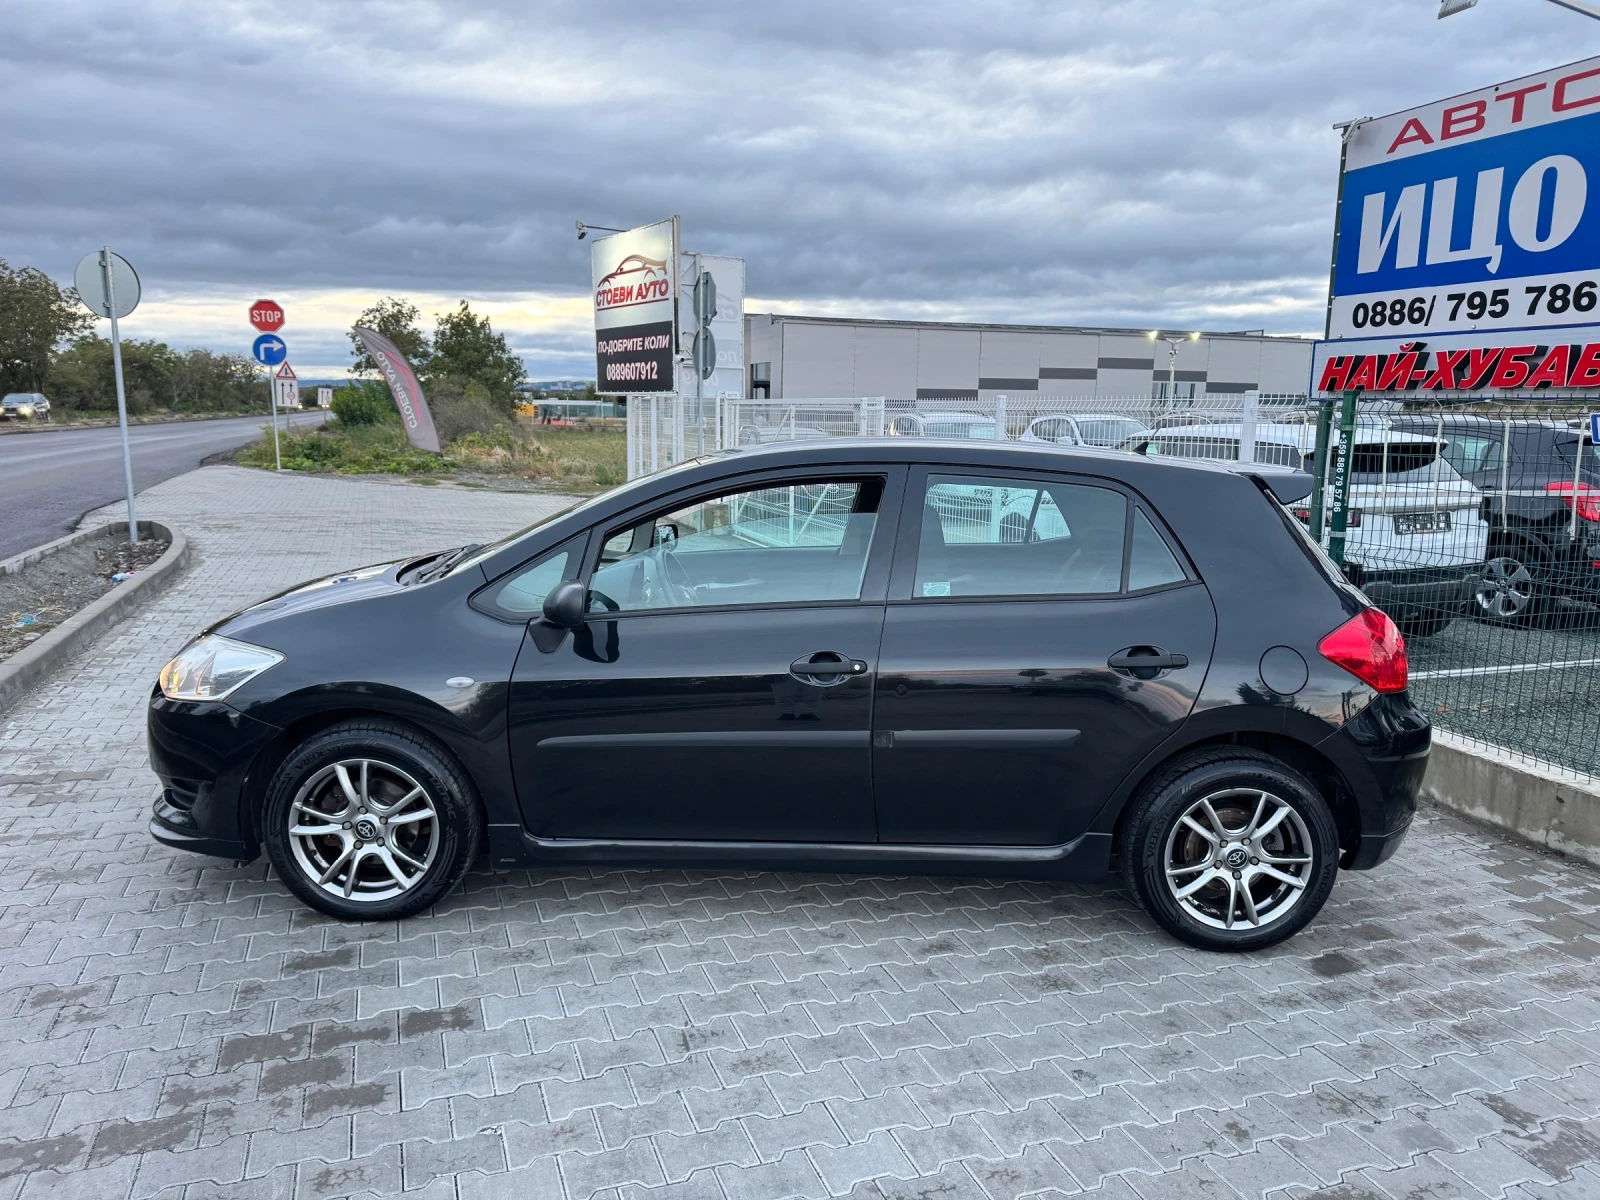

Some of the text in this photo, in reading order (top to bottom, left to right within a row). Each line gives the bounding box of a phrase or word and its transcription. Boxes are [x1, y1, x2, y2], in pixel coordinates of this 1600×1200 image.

[1357, 154, 1588, 275] ИЦО
[596, 278, 669, 307] СТОЕВИ АУТО
[1352, 281, 1598, 328] 0886/ 795 786
[252, 310, 281, 322] STOP
[597, 334, 669, 356] ПО-ДОБРИТЕ КОЛИ
[606, 360, 659, 381] 0889607912
[1333, 433, 1348, 513] +359 886 79 57 86
[1146, 801, 1180, 858] VREDESTEIN
